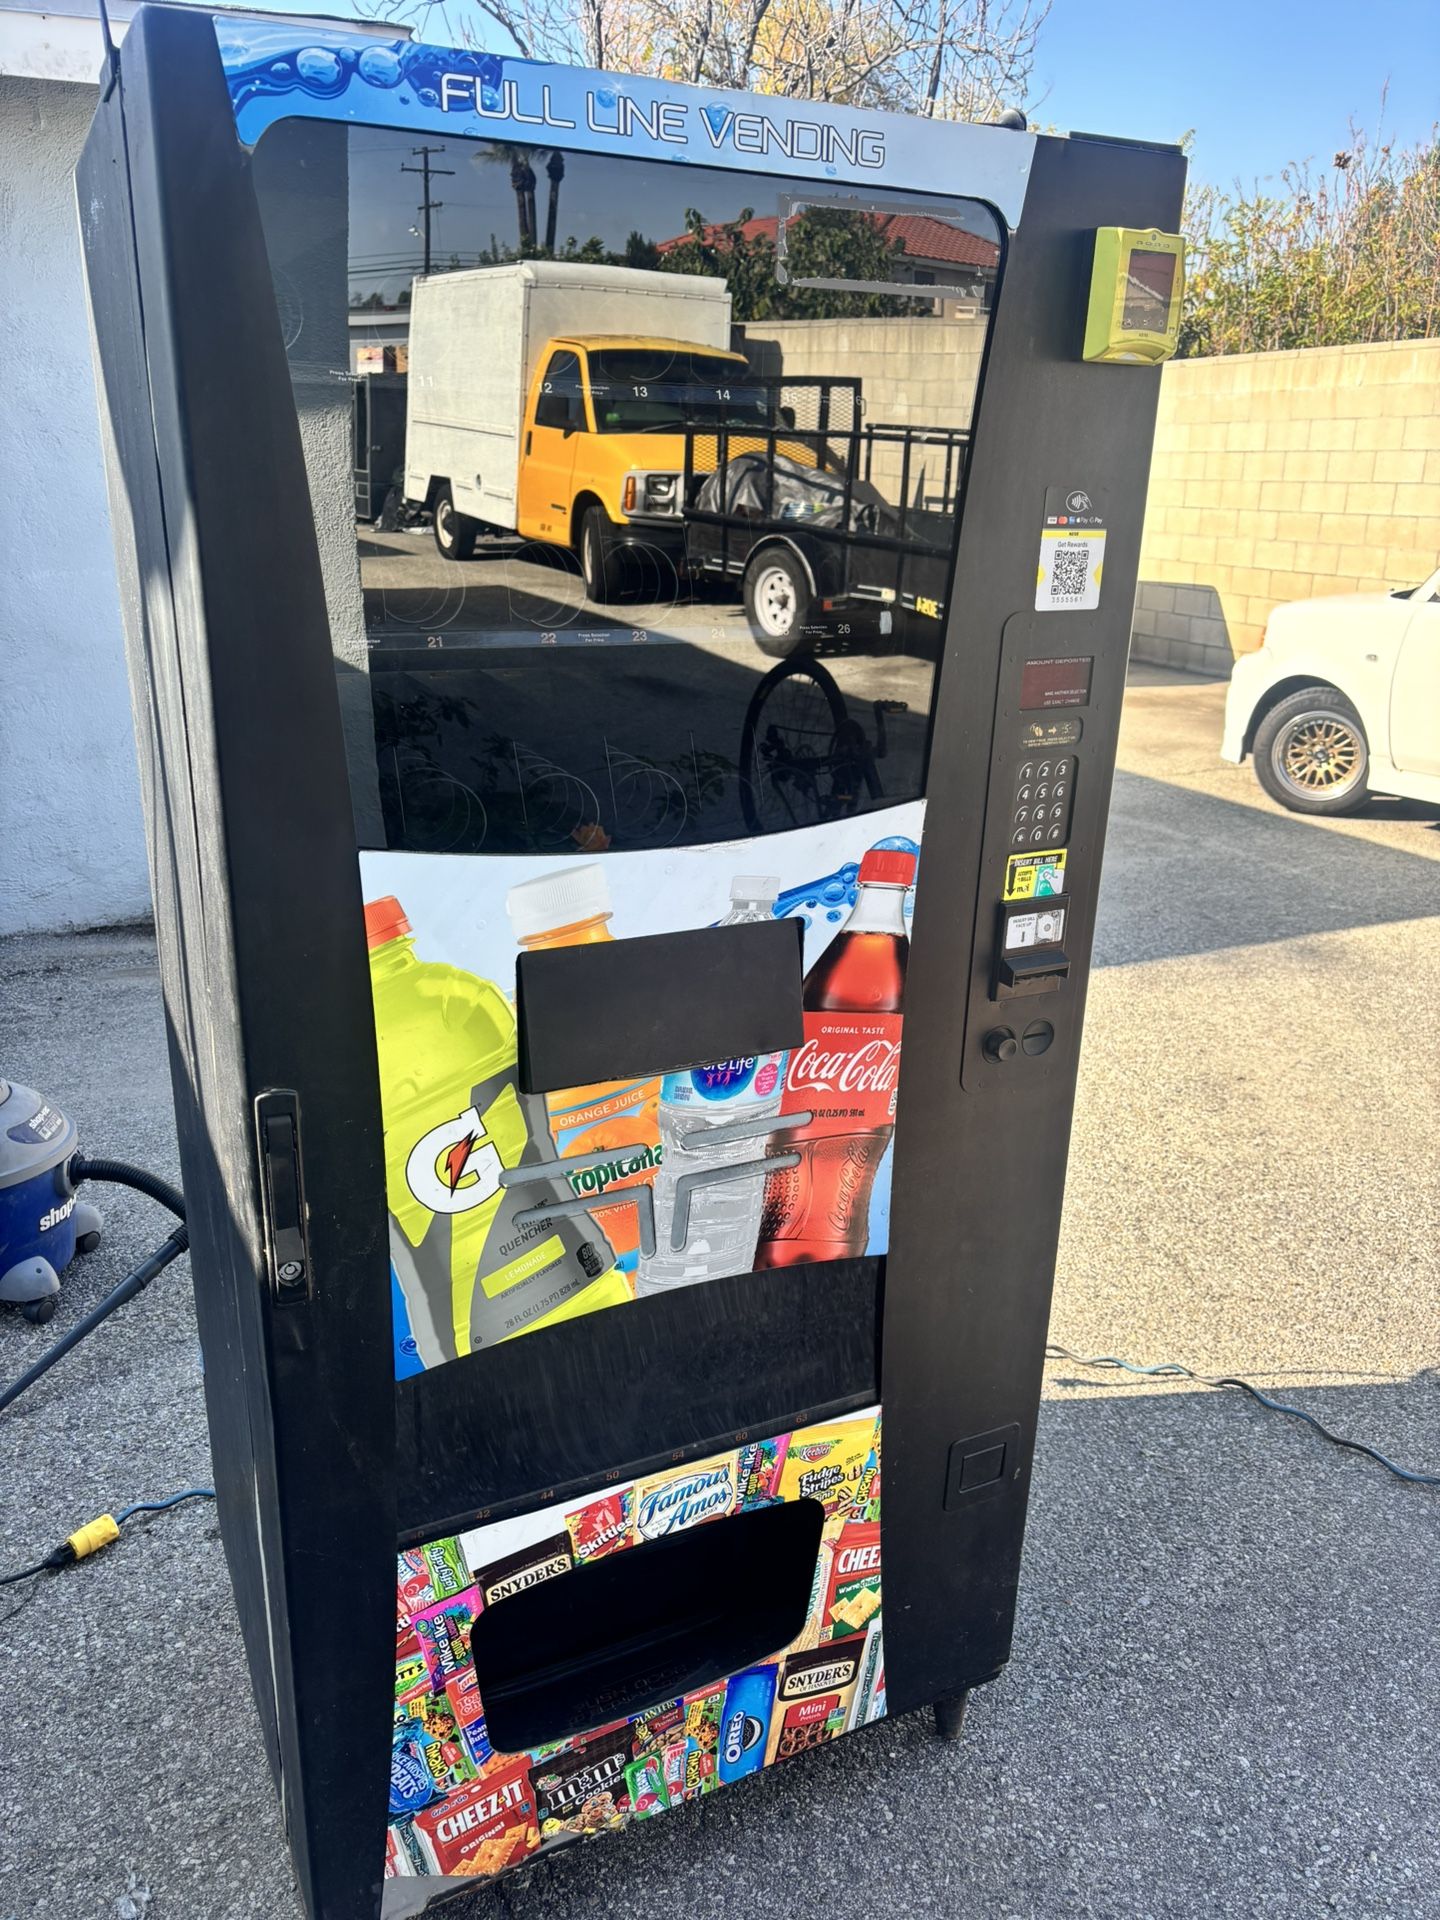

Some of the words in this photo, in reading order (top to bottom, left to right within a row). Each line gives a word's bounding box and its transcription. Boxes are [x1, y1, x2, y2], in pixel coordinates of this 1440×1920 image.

[440, 72, 576, 129] FULL
[586, 91, 688, 144] LINE
[699, 106, 886, 168] VENDING
[536, 382, 553, 394] 12
[632, 386, 648, 397] 13
[715, 389, 731, 401] 14
[540, 633, 557, 644] 22
[632, 631, 648, 642] 23
[711, 628, 725, 639] 24
[838, 623, 851, 634] 26
[427, 636, 443, 648] 21
[1025, 768, 1031, 778] 1
[1041, 766, 1050, 777] 2
[1059, 765, 1067, 775] 3
[1021, 789, 1029, 800] 4
[1039, 788, 1047, 798] 5
[1057, 786, 1064, 797] 6
[1019, 811, 1027, 822] 7
[1036, 809, 1044, 820] 8
[1054, 807, 1062, 818] 9
[1034, 831, 1042, 841] 0
[1014, 858, 1033, 867] INSERT
[1033, 857, 1044, 866] BILL
[1045, 855, 1058, 864] HERE
[821, 1026, 859, 1034] ORIGINAL
[862, 1027, 885, 1035] TASTE
[728, 1055, 754, 1075] Life
[788, 1039, 902, 1092] Coca-Cola
[559, 1105, 611, 1127] ORANGE
[612, 1089, 646, 1109] JUICE
[405, 1104, 507, 1215] G
[565, 1144, 663, 1196] ropicana
[499, 1217, 553, 1256] QUENCHER
[581, 1245, 593, 1259] 80
[504, 1252, 547, 1281] LEMONADE
[500, 1277, 536, 1299] ARTIFICIALLY
[504, 1317, 515, 1330] 28
[514, 1314, 523, 1325] FL
[523, 1308, 534, 1320] OZ
[735, 1432, 748, 1442] 60
[672, 1450, 685, 1461] 54
[743, 1443, 758, 1464] Ike
[606, 1470, 620, 1480] 50
[747, 1474, 759, 1495] SOUR
[800, 1465, 841, 1486] Fudge
[801, 1473, 845, 1497] Stripes
[540, 1491, 555, 1500] 44
[637, 1466, 731, 1529] Famous
[475, 1509, 491, 1519] 42
[657, 1488, 733, 1536] Amos
[691, 1506, 718, 1523] COOKIES
[578, 1517, 634, 1559] Skittles
[490, 1557, 568, 1601] SNYDER'S
[433, 1614, 449, 1639] Ike
[438, 1638, 457, 1675] Mike
[450, 1638, 467, 1660] SOUR
[787, 1664, 852, 1690] SNYDER'S
[635, 1700, 678, 1728] PLANTERS
[798, 1701, 827, 1717] Mini
[725, 1711, 745, 1763] OREO
[405, 1756, 428, 1790] KRISPIES
[574, 1771, 625, 1806] Cookies
[432, 1803, 451, 1818] Grab
[456, 1793, 469, 1803] Go
[436, 1778, 523, 1843] CHEEZ-IT
